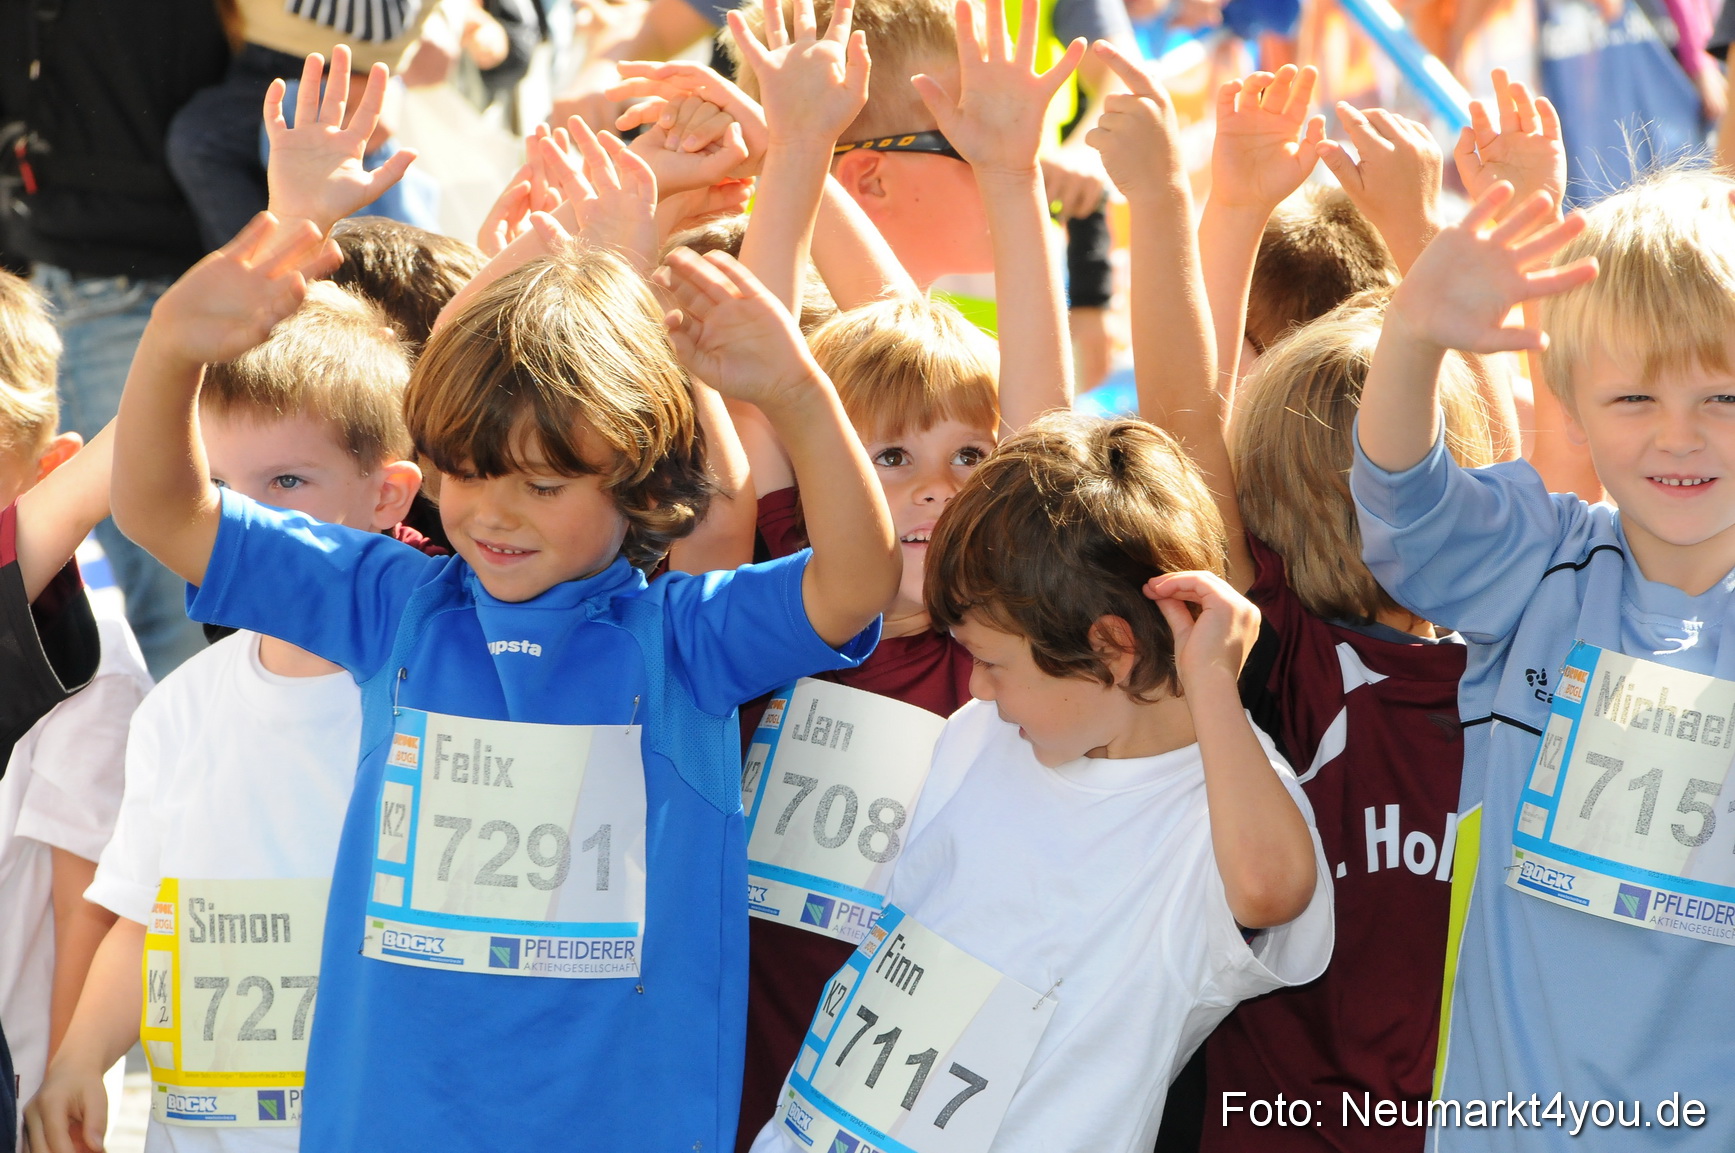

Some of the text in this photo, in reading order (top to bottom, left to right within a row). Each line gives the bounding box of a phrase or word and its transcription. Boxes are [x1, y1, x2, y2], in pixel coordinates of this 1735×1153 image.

[792, 698, 854, 752] Jan
[1594, 670, 1735, 749] Michael
[433, 733, 514, 789] Felix
[1539, 732, 1564, 771] K2
[741, 761, 761, 793] K2
[382, 801, 406, 838] K2
[774, 771, 907, 864] 708
[433, 814, 612, 891] 7291
[1364, 804, 1457, 883] Hol
[1521, 860, 1576, 891] BOCK
[188, 897, 291, 943] Simon
[382, 930, 445, 954] BOCK
[524, 938, 635, 959] PFLEIDERER
[523, 961, 636, 974] AKTIENGESELLSCHAFT
[875, 933, 925, 996] Finn
[822, 980, 847, 1018] K2
[835, 1004, 989, 1130] 7117
[167, 1094, 217, 1112] BOCK
[788, 1101, 814, 1131] BOCK
